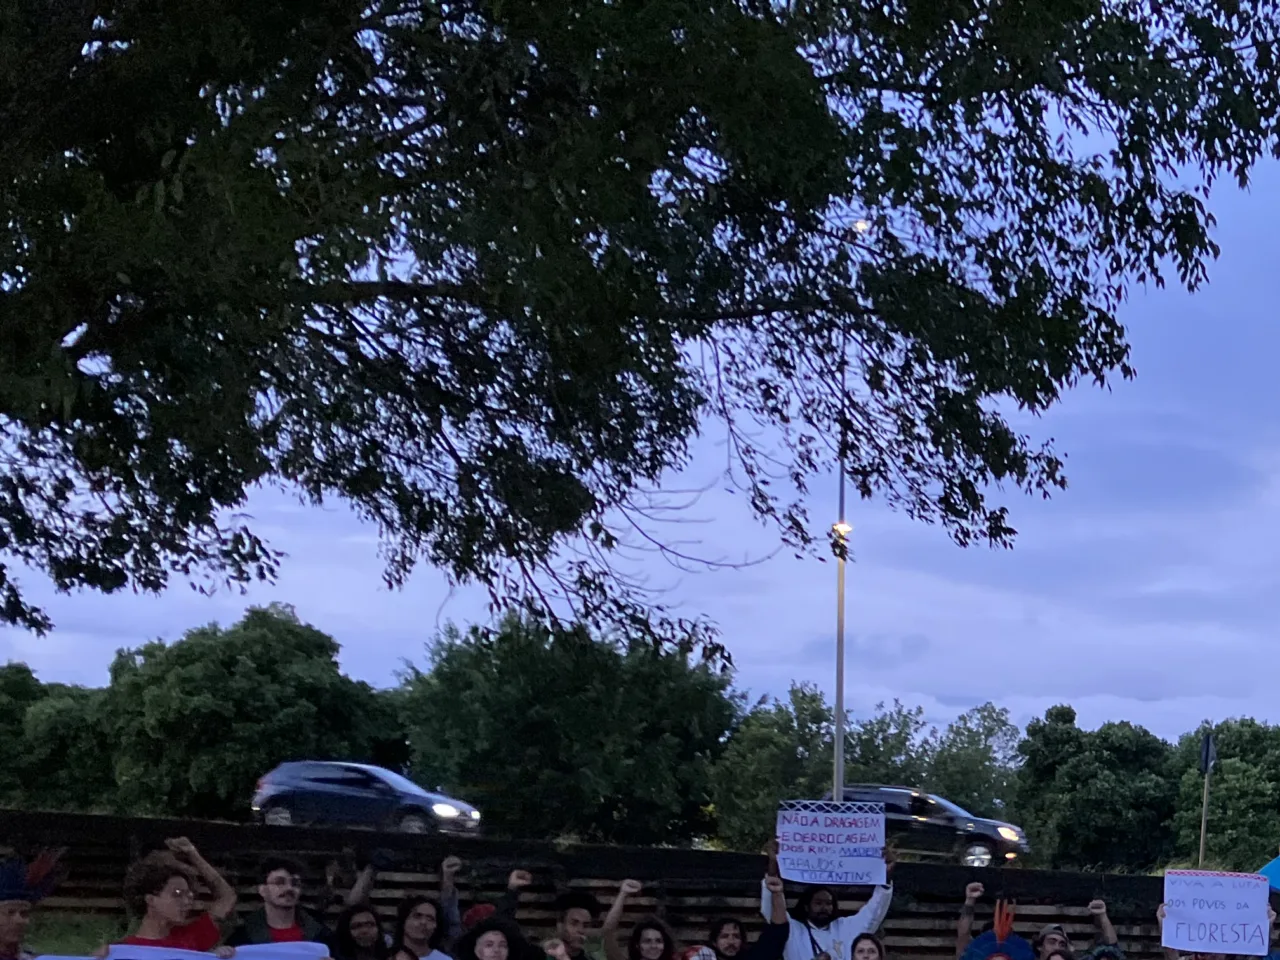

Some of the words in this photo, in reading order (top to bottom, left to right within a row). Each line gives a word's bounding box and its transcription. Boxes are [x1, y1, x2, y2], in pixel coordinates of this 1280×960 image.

[782, 813, 808, 826] NÃO
[810, 816, 820, 827] A
[824, 816, 880, 828] DRAGAGEM
[1168, 878, 1204, 888] VIVA
[1175, 922, 1265, 946] FLORESTA
